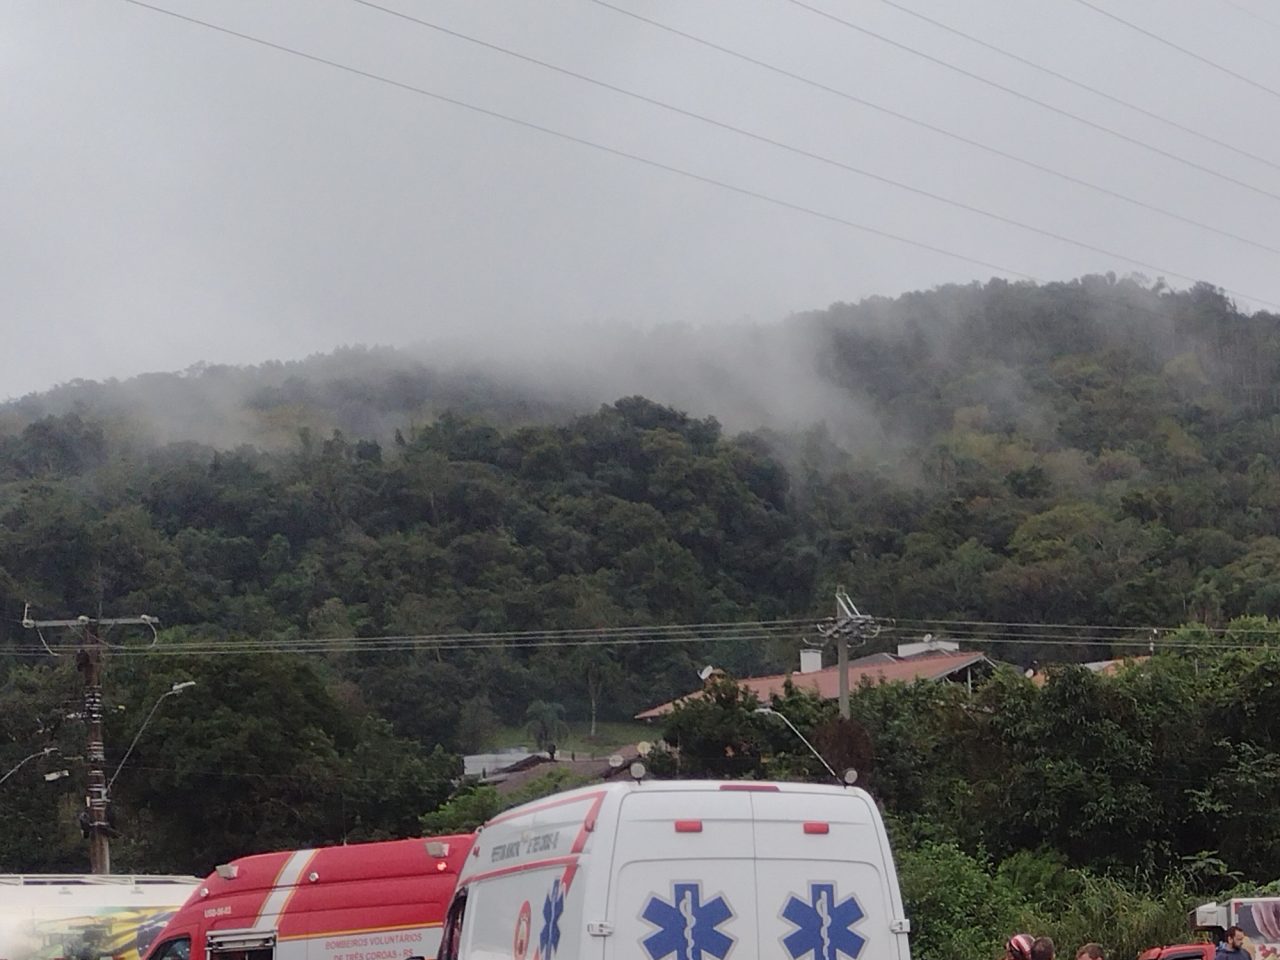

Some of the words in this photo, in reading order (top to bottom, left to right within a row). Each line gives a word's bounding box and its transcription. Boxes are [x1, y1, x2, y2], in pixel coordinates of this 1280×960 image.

[325, 937, 368, 950] BOMBEIROS
[366, 949, 397, 960] COROAS
[403, 948, 414, 957] RS
